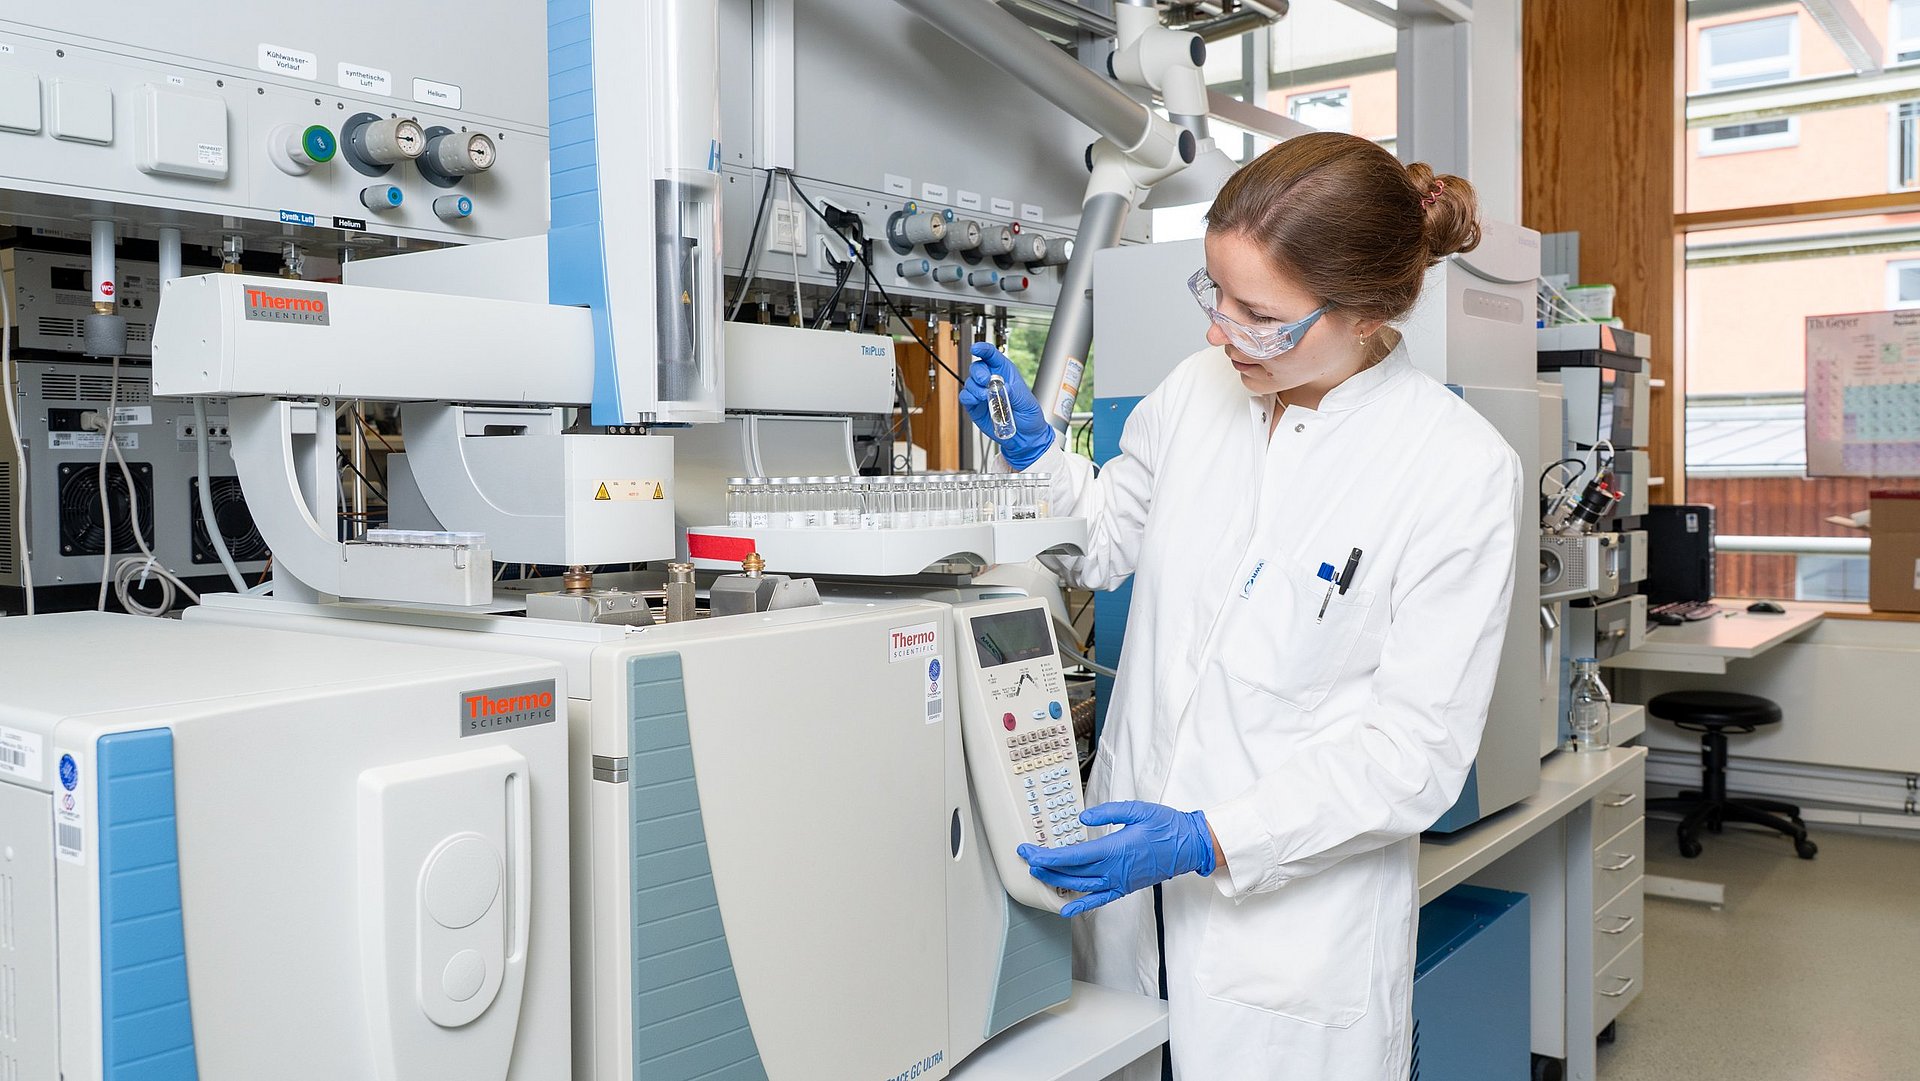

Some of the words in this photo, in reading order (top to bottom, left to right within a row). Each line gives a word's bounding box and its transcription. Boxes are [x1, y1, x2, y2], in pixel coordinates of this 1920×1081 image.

[266, 50, 309, 64] Kühlwasser-
[276, 60, 300, 71] Vorlauf
[345, 70, 385, 83] synthetische
[360, 79, 373, 87] Luft
[427, 89, 447, 99] Helium
[281, 211, 300, 222] Synth.
[301, 214, 313, 224] Luft
[338, 219, 361, 229] Helium
[247, 289, 324, 314] Thermo
[252, 309, 323, 322] SCIENTIFIC
[892, 630, 935, 649] Thermo
[893, 644, 934, 658] SCIENTIFIC
[465, 691, 553, 719] Thermo
[470, 709, 551, 730] SCIENTIFIC
[910, 1061, 922, 1080] GC
